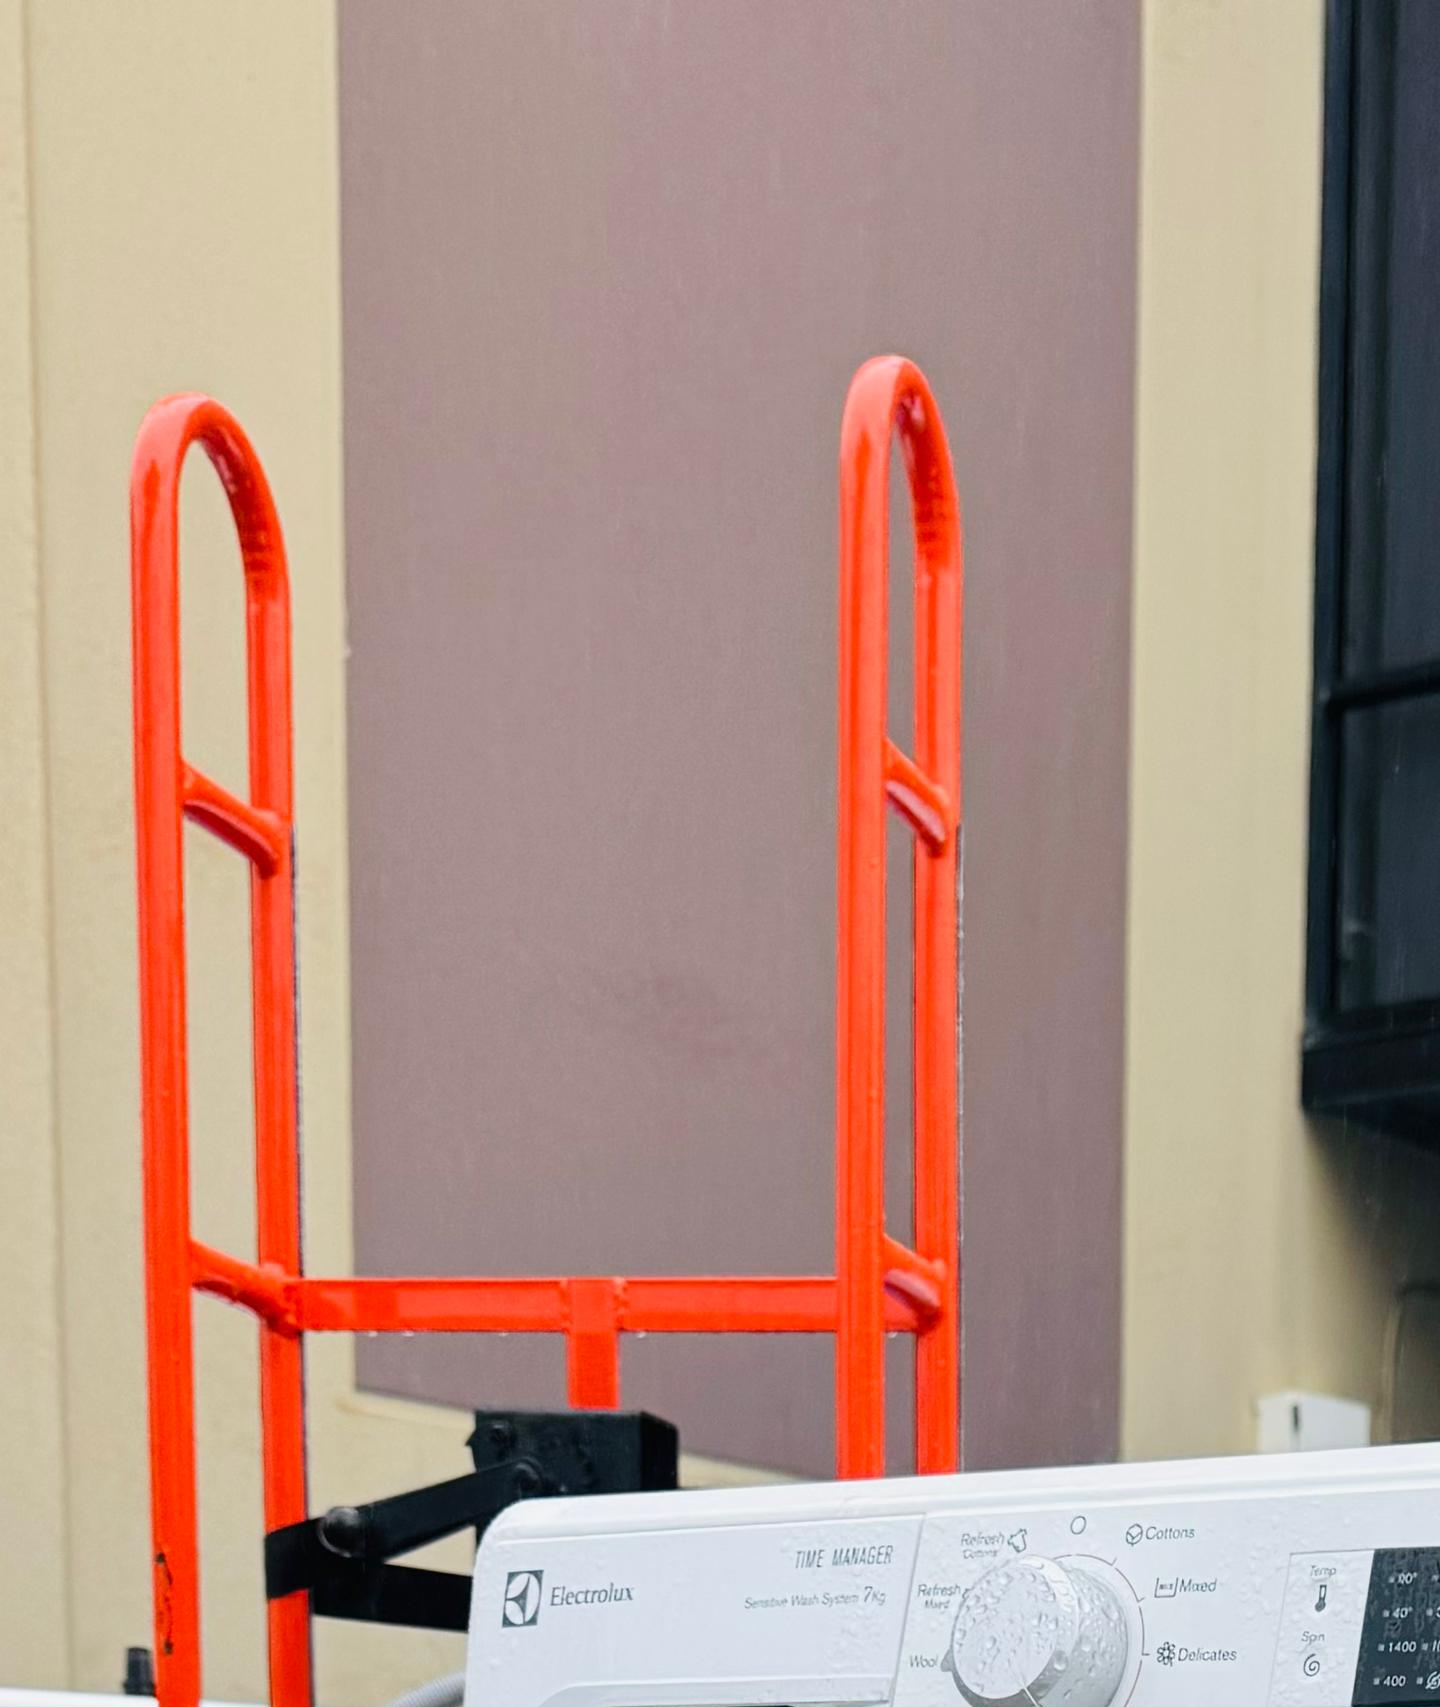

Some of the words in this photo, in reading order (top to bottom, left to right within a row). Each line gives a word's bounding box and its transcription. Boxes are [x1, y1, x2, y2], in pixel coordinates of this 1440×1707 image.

[1145, 1526, 1195, 1540] Cottons
[795, 1549, 824, 1568] TIME
[832, 1545, 893, 1566] MANAGER
[550, 1583, 635, 1607] Electrolux
[1388, 1641, 1416, 1652] 1400
[909, 1655, 938, 1668] Wool
[1177, 1647, 1237, 1662] Delicates
[1383, 1675, 1406, 1687] 400
